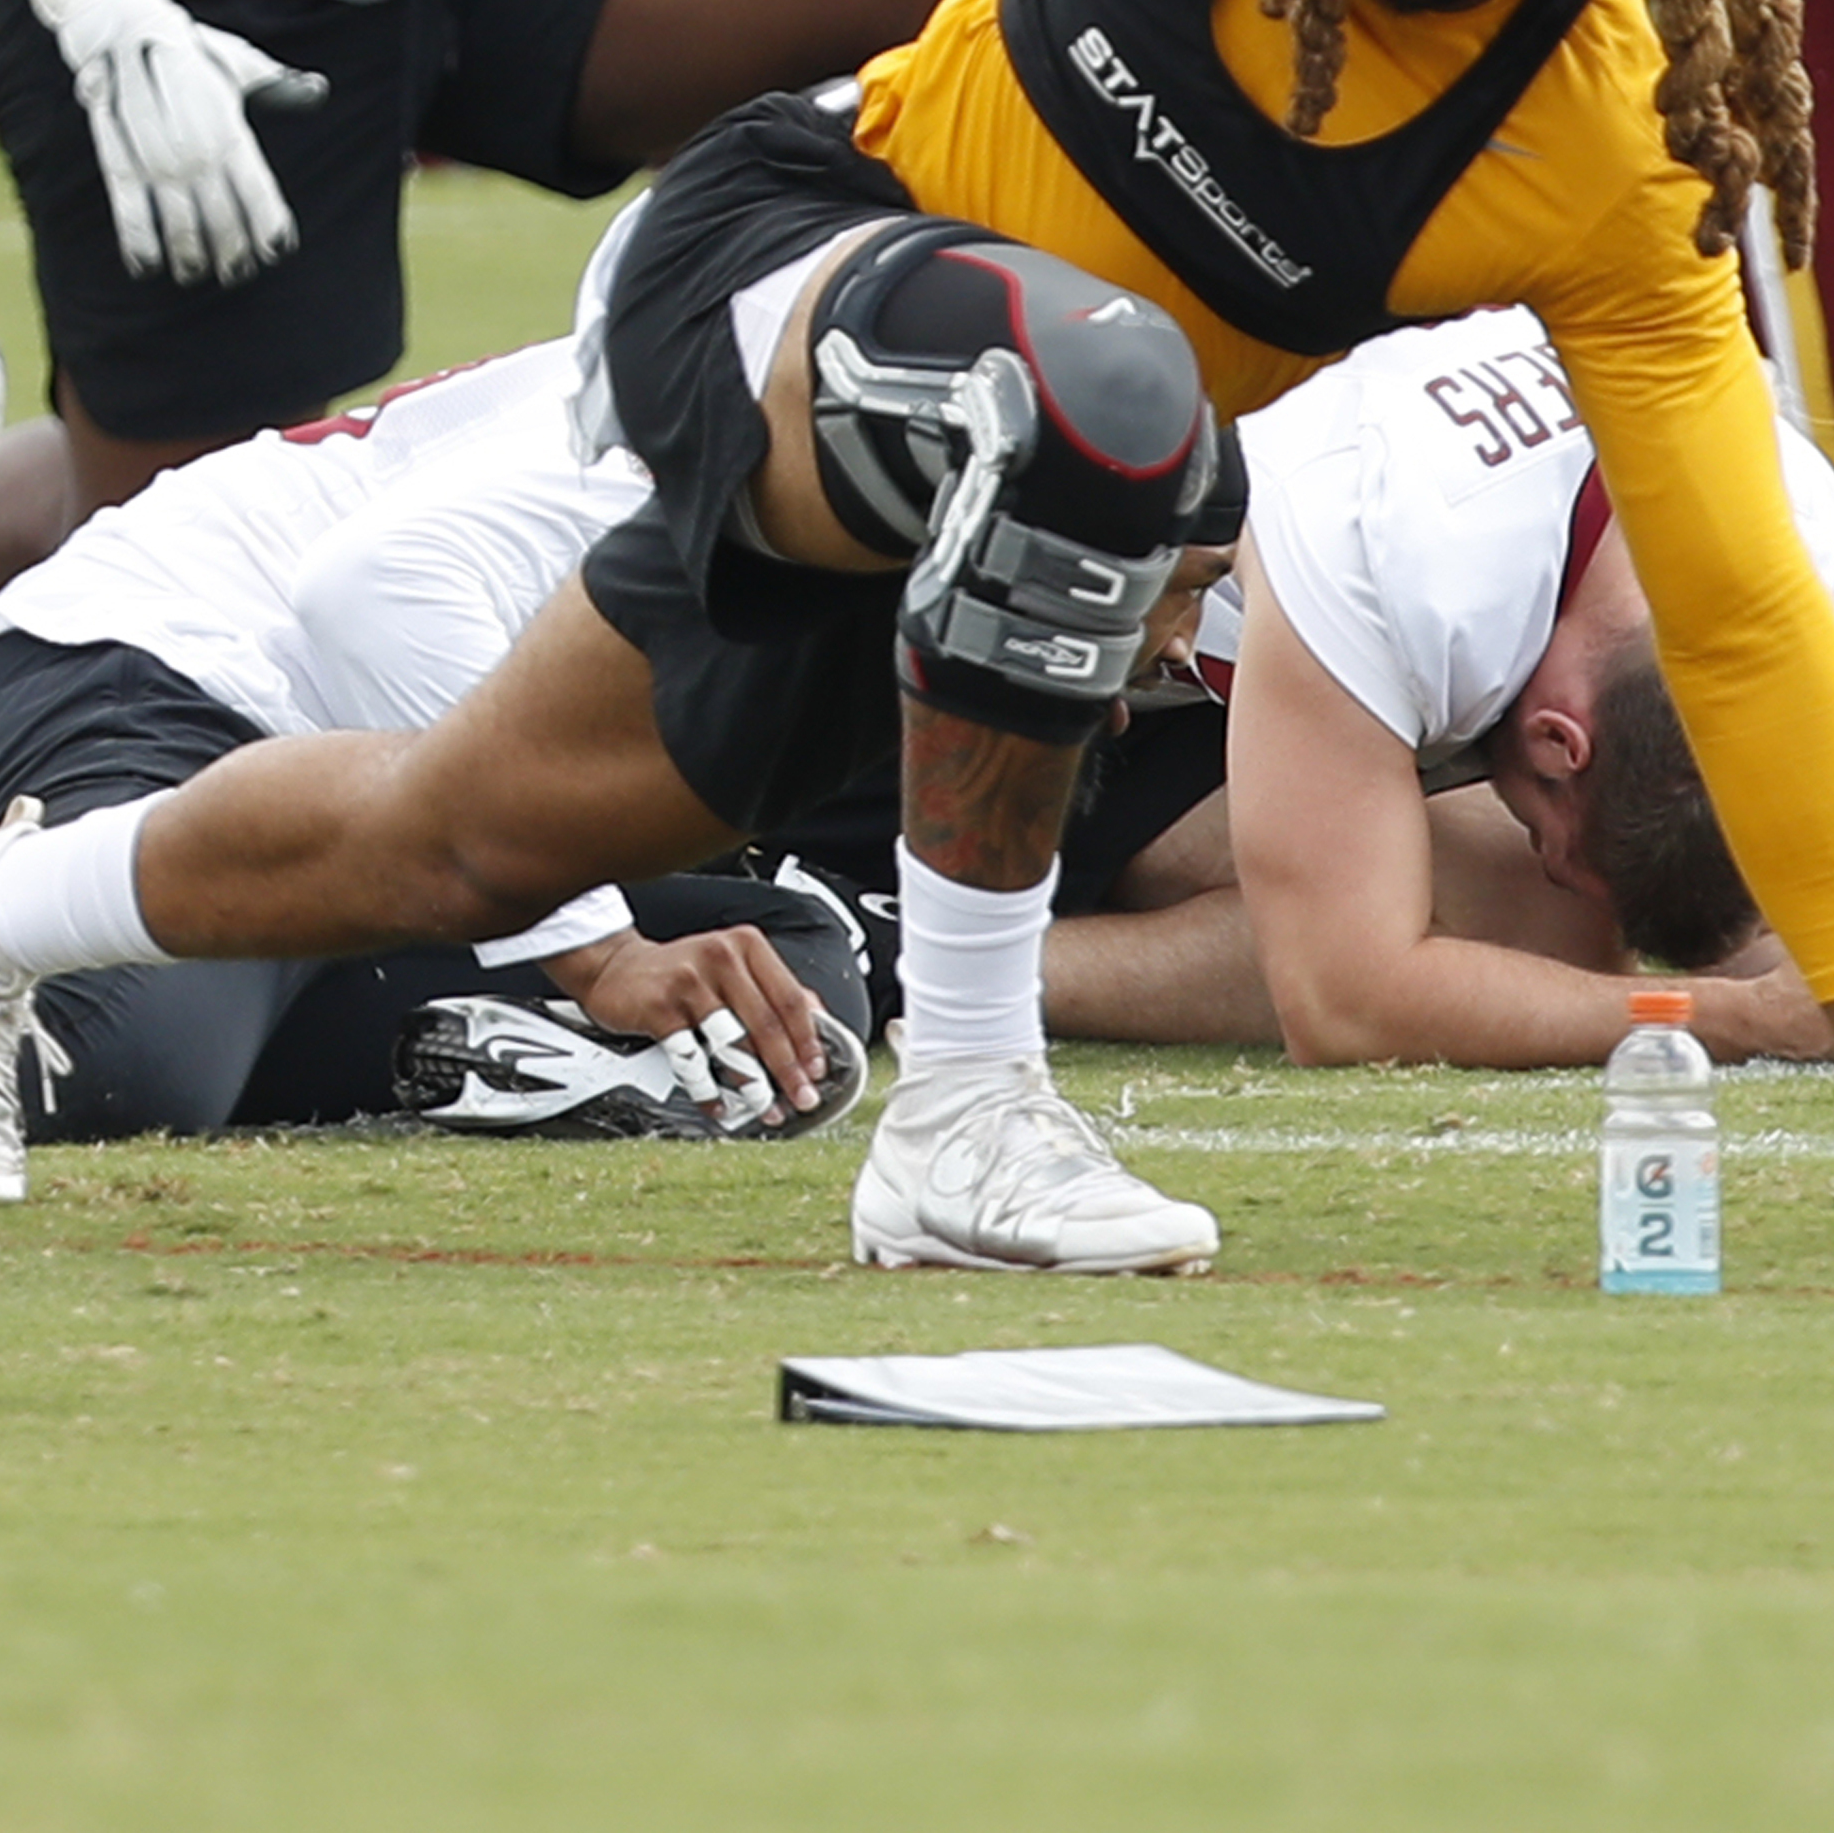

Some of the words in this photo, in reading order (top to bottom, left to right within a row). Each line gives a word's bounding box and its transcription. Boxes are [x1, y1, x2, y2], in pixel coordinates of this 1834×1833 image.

[1068, 27, 1312, 287] STATSports
[1635, 1154, 1674, 1200] G
[1639, 1211, 1674, 1257] 2
